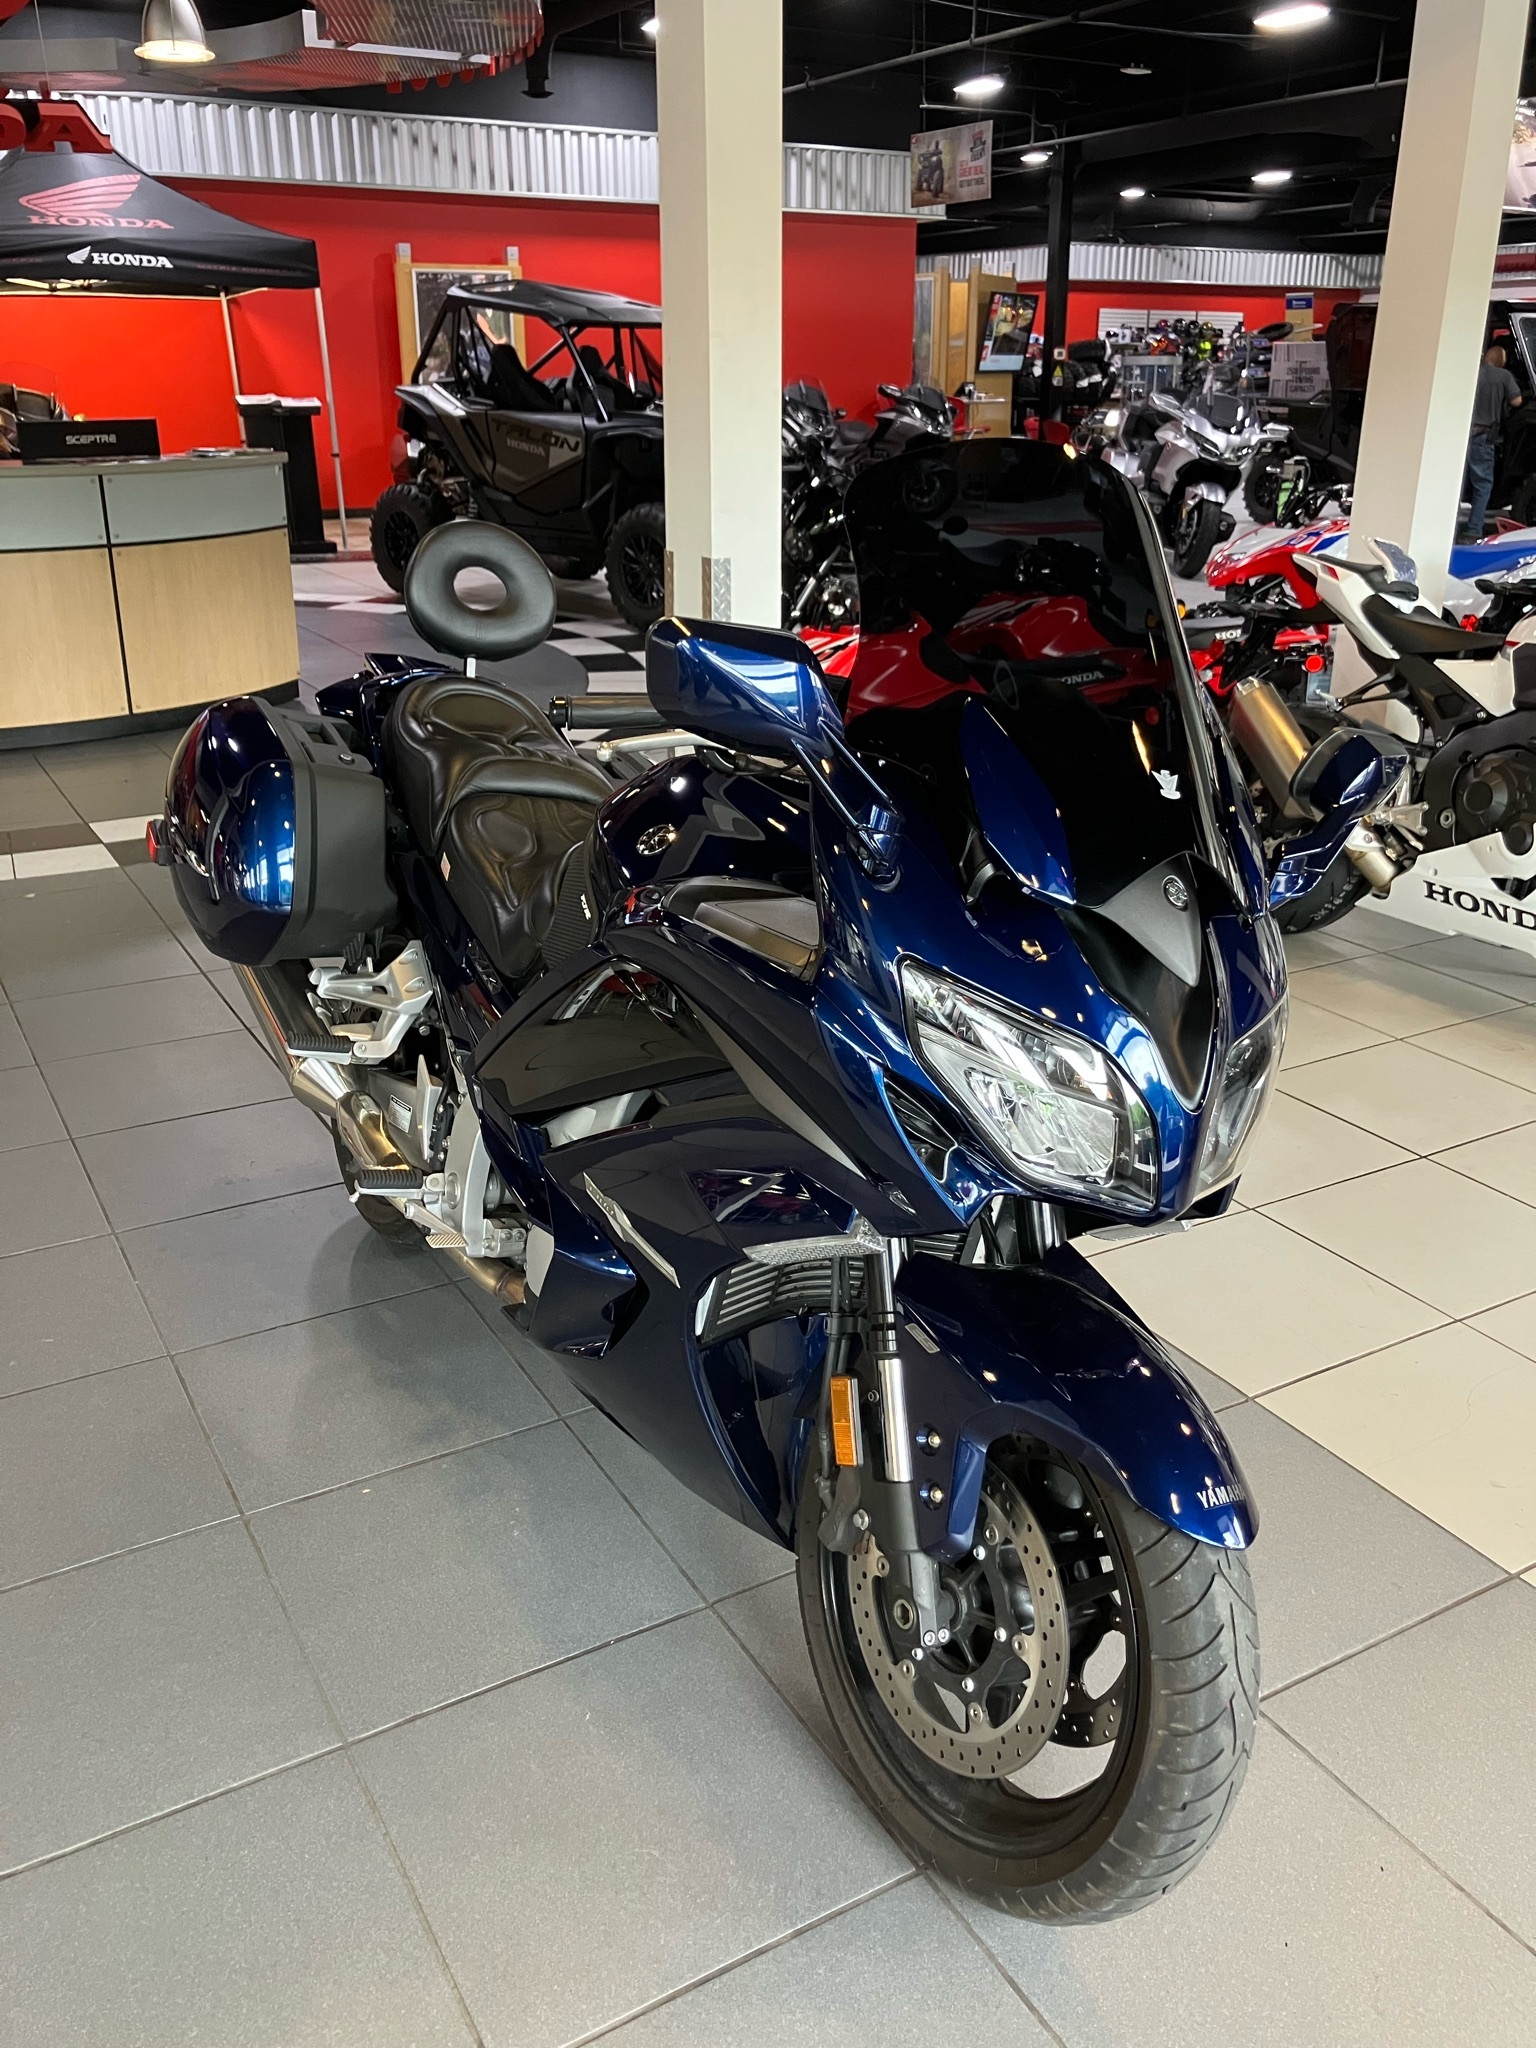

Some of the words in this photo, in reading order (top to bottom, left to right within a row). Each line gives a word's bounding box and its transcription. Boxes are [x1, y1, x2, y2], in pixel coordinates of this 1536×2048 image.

[27, 215, 175, 230] HONDA
[91, 252, 174, 268] HONDA
[65, 433, 117, 445] SCEPTRE
[507, 438, 546, 458] HONDA
[1061, 670, 1105, 684] ONDA
[1196, 1483, 1247, 1509] YAMAHA
